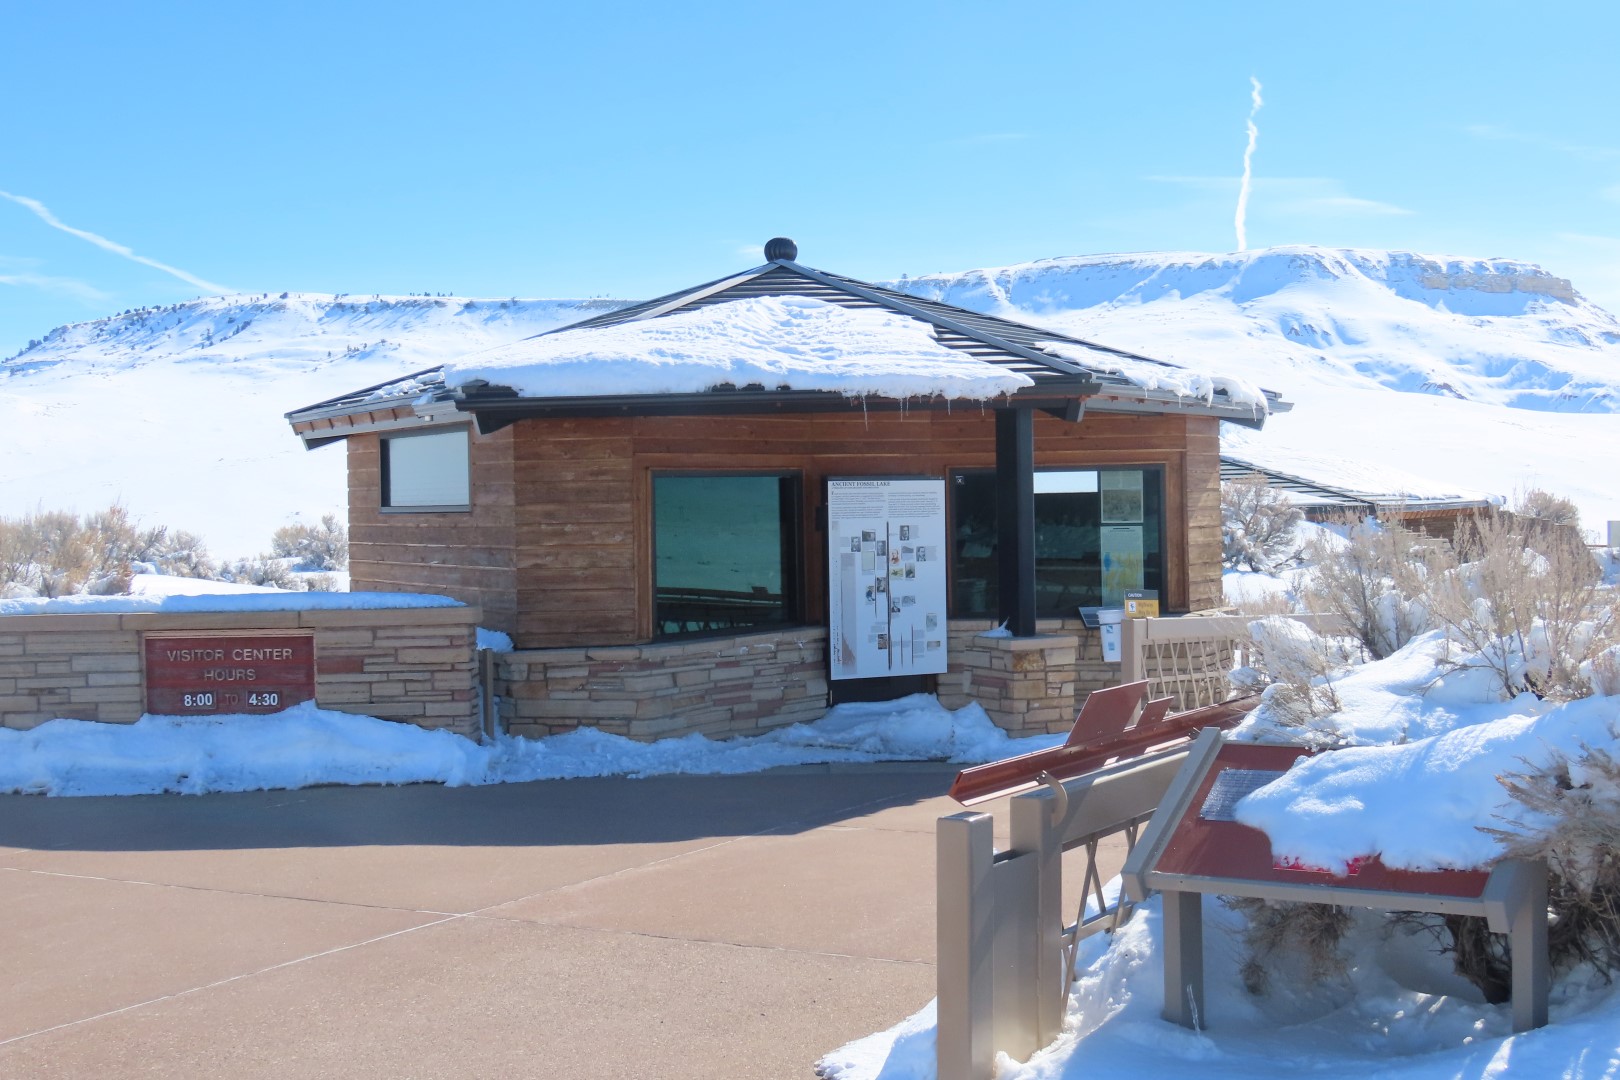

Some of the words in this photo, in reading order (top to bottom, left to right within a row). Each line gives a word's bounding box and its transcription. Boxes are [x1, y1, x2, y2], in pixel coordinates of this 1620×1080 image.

[167, 649, 225, 662] VISITOR
[232, 648, 293, 661] CENTER
[204, 668, 256, 681] HOURS
[184, 693, 213, 707] 8:00
[224, 694, 239, 705] TO
[249, 693, 278, 706] 4:30
